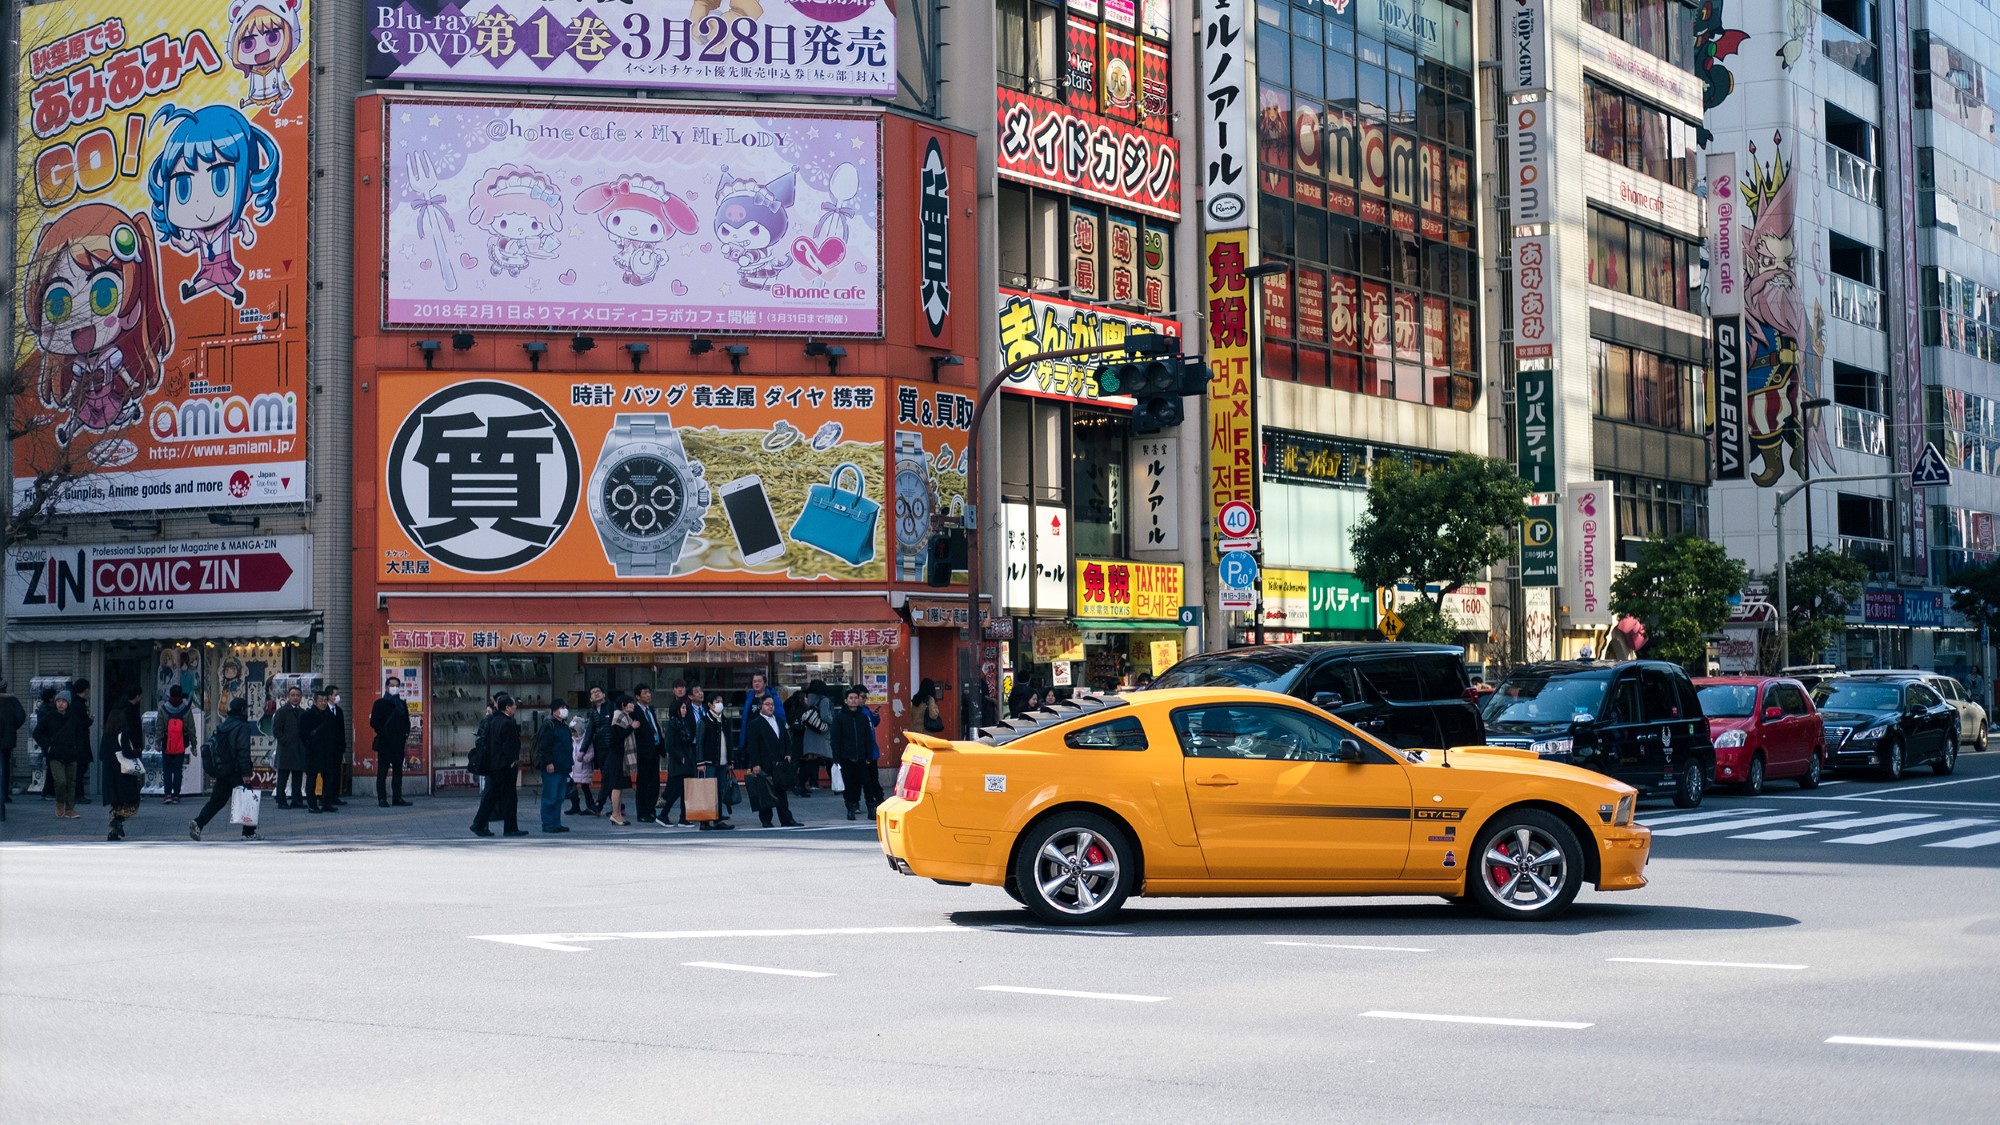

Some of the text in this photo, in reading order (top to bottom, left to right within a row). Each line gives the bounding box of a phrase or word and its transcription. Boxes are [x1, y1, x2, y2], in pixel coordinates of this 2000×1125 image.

[377, 6, 474, 33] Blu-ray
[32, 20, 124, 76] 秋葉原でも
[377, 31, 472, 56] & DVD
[471, 11, 613, 61] 第1巻
[621, 12, 887, 68] 3月28日発売
[33, 34, 221, 133] あみあみへ
[486, 119, 574, 142] @home
[579, 121, 627, 142] cafe
[651, 124, 685, 145] MY
[692, 126, 790, 148] MELODY
[1003, 109, 1171, 198] メイドカジノ
[1518, 109, 1539, 220] amiami
[1620, 181, 1664, 214] @home cafe
[1717, 203, 1731, 295] @home cafe
[771, 283, 866, 300] @home cafe
[1209, 242, 1247, 348] 免税
[1265, 289, 1284, 308] Tax
[1520, 242, 1544, 340] あみあみ
[1264, 309, 1287, 329] Free
[572, 384, 875, 409] 時計 バッグ 貴金属 ダイヤ 携帯
[1718, 324, 1737, 472] GALLERIA
[152, 396, 294, 438] amiami
[1232, 357, 1251, 505] TAX FREE
[1525, 381, 1547, 483] リバティー
[149, 438, 297, 461] http://www.amiami.jp/
[108, 484, 138, 498] Anime
[141, 482, 172, 499] goods
[175, 480, 194, 494] and
[197, 481, 223, 492] more
[263, 487, 278, 495] Shop
[1147, 460, 1166, 544] ルノアール
[1227, 511, 1247, 528] 40
[93, 539, 277, 556] Professional Support for Magazine & MANGA-ZIN
[385, 550, 409, 558] チケット
[15, 549, 86, 612] ZIN
[96, 559, 240, 595] COMIC ZIN
[386, 560, 431, 575] 大黒屋
[1135, 565, 1178, 594] TAX FREE
[1228, 561, 1242, 585] P
[1237, 573, 1249, 585] 60
[1546, 565, 1557, 575] IN
[1583, 520, 1598, 613] @home cafe
[1083, 563, 1131, 604] 免税
[93, 596, 174, 612] Akihabara
[1137, 594, 1179, 618] 면세점
[1312, 586, 1370, 612] リバティー
[393, 629, 466, 649] 高価買取
[830, 628, 899, 647] 無料査定
[1418, 811, 1460, 819] GT/CS
